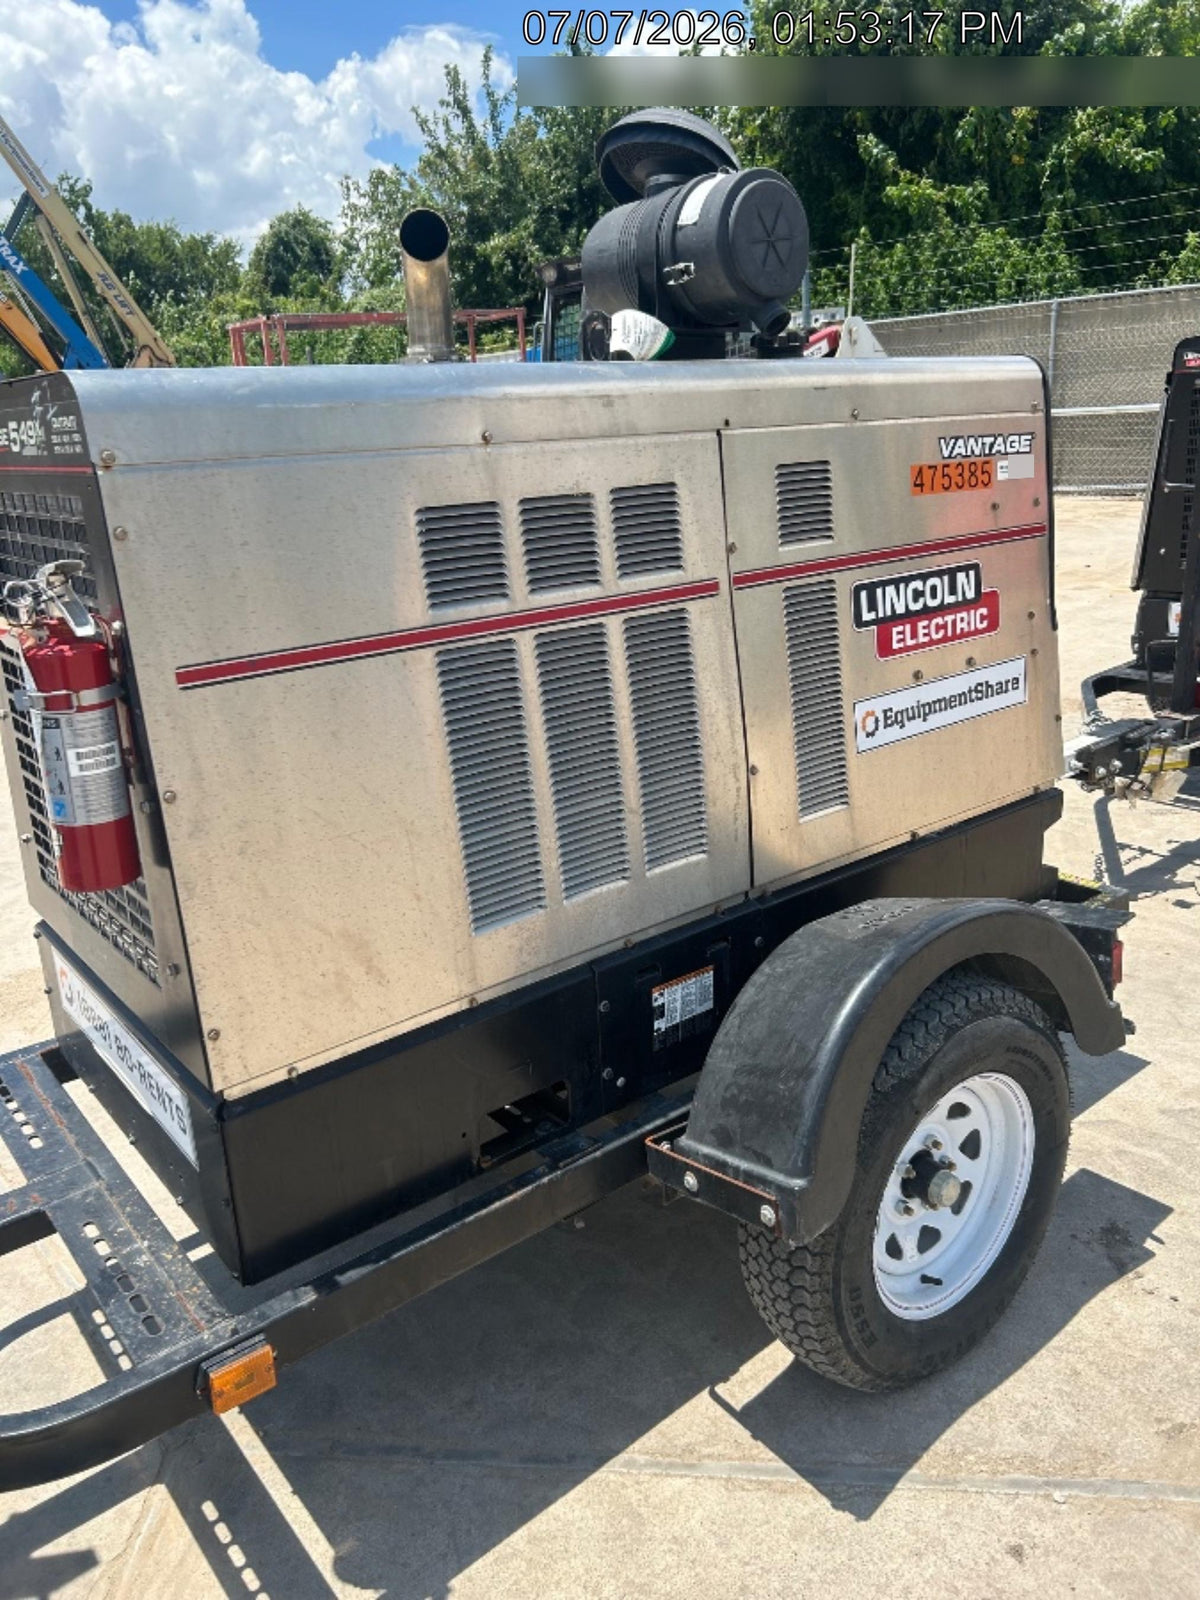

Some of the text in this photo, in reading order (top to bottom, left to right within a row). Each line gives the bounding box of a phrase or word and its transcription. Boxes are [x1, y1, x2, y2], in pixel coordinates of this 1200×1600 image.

[939, 433, 1033, 460] VANTAGE
[912, 460, 992, 494] 475385
[859, 569, 977, 623] LINCOLN
[891, 607, 989, 650] ELECTRIC
[882, 674, 1021, 731] EquipmentShare
